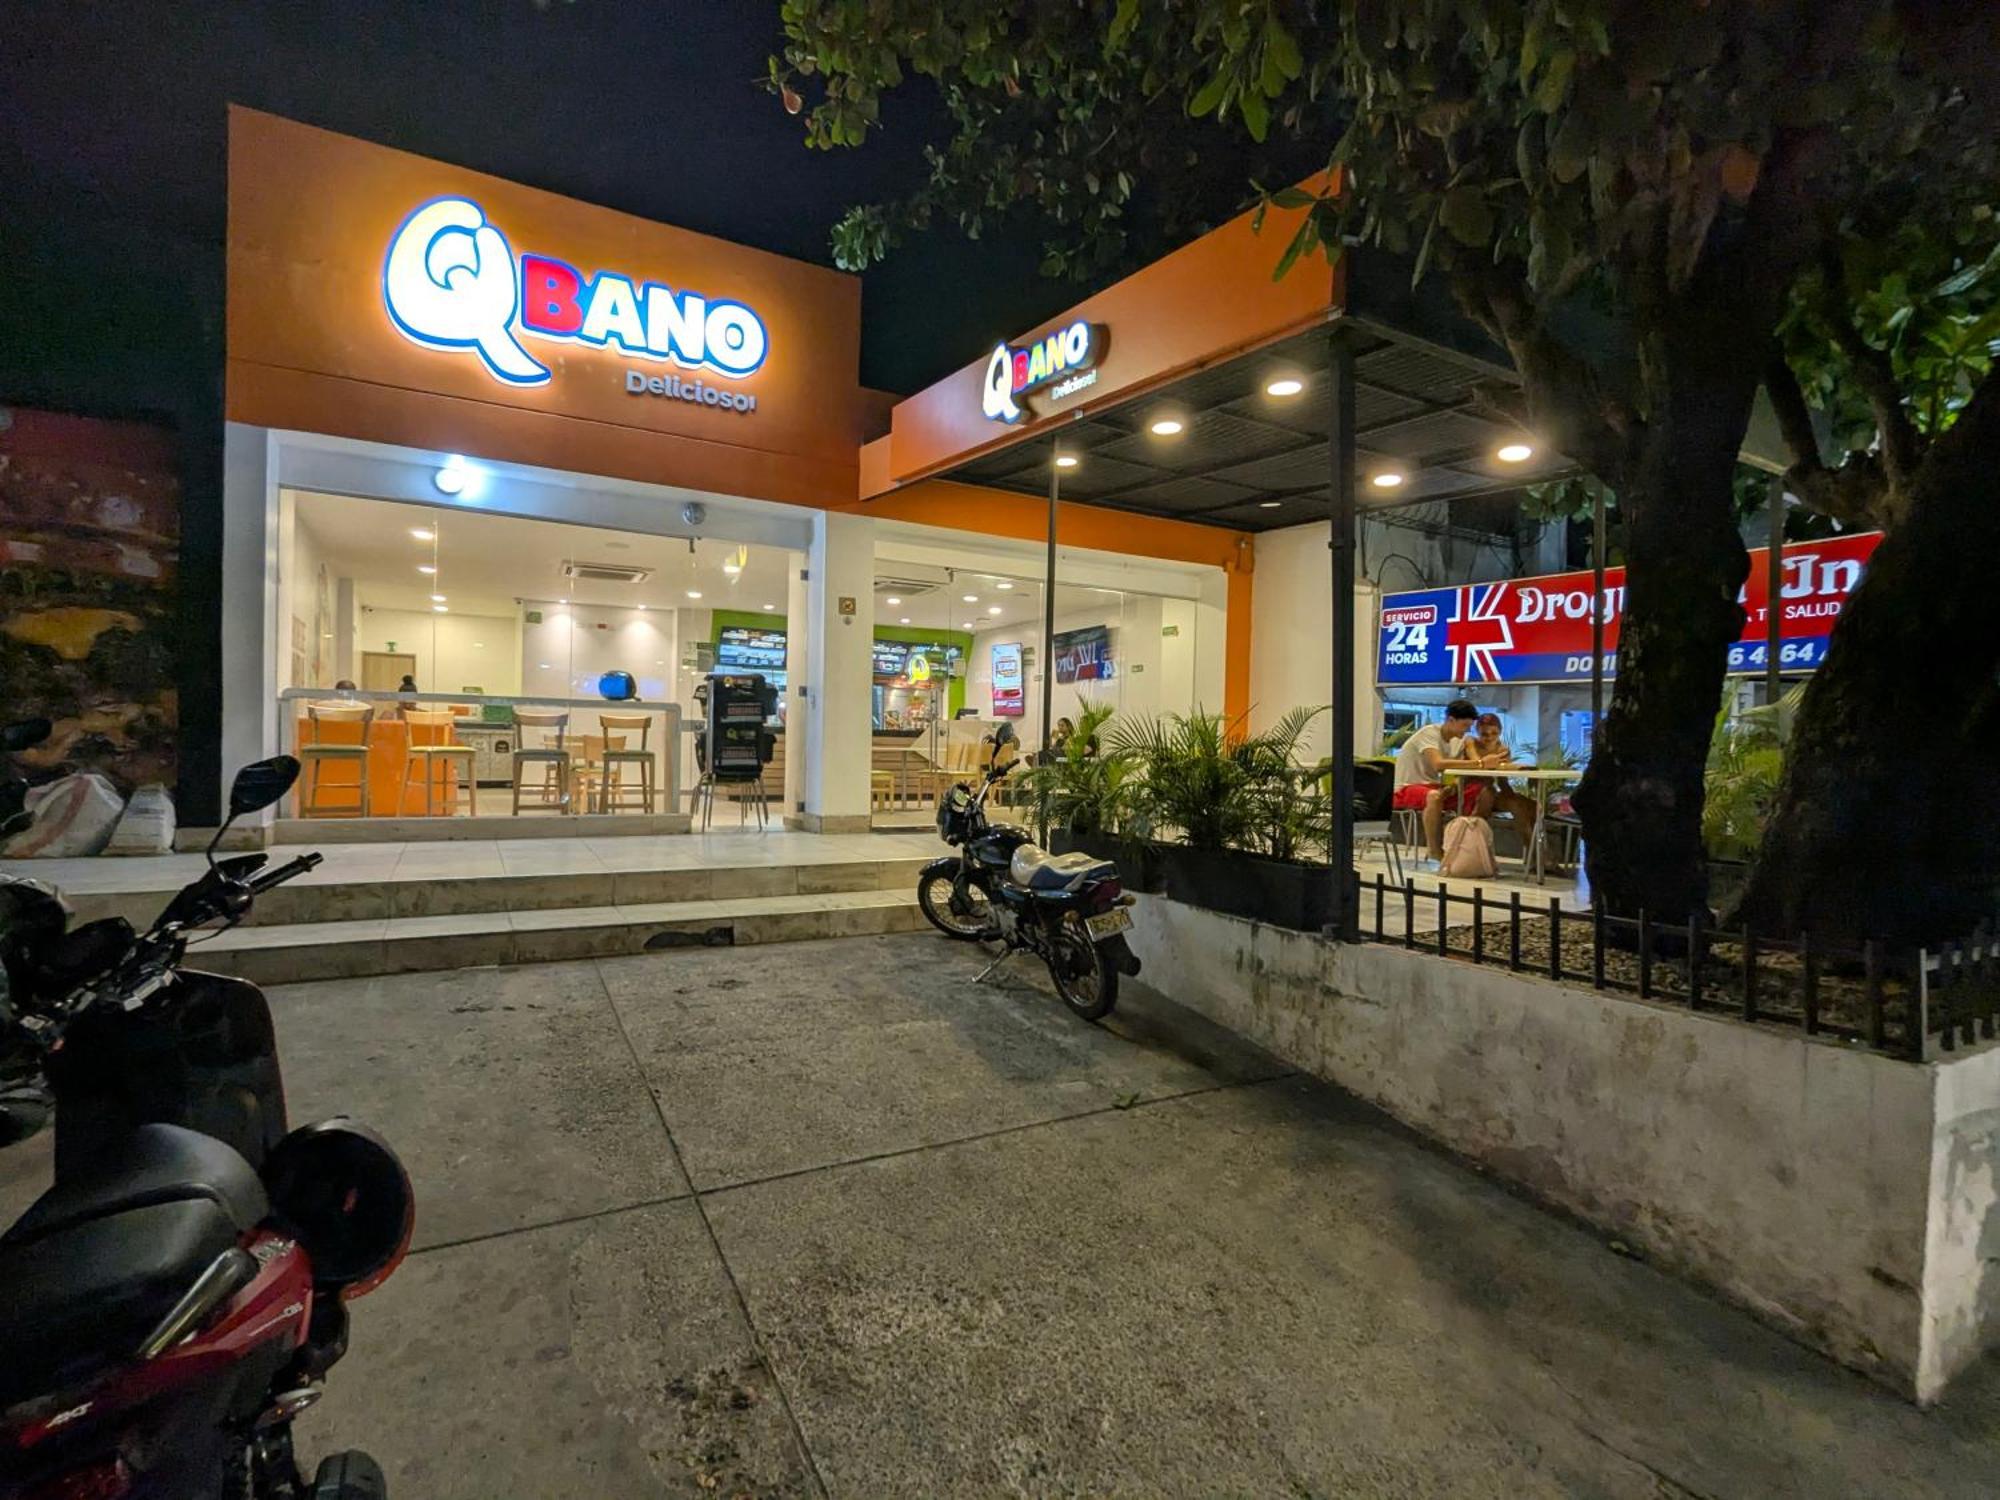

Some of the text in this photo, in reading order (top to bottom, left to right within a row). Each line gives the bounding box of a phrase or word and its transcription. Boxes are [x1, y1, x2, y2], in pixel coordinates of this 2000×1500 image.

[384, 195, 769, 386] QBANO
[982, 319, 1091, 423] QBANO
[1386, 610, 1431, 623] SERVICIO
[1785, 602, 1841, 619] SALUD
[1386, 621, 1429, 651] 24
[1386, 652, 1428, 665] HORAS
